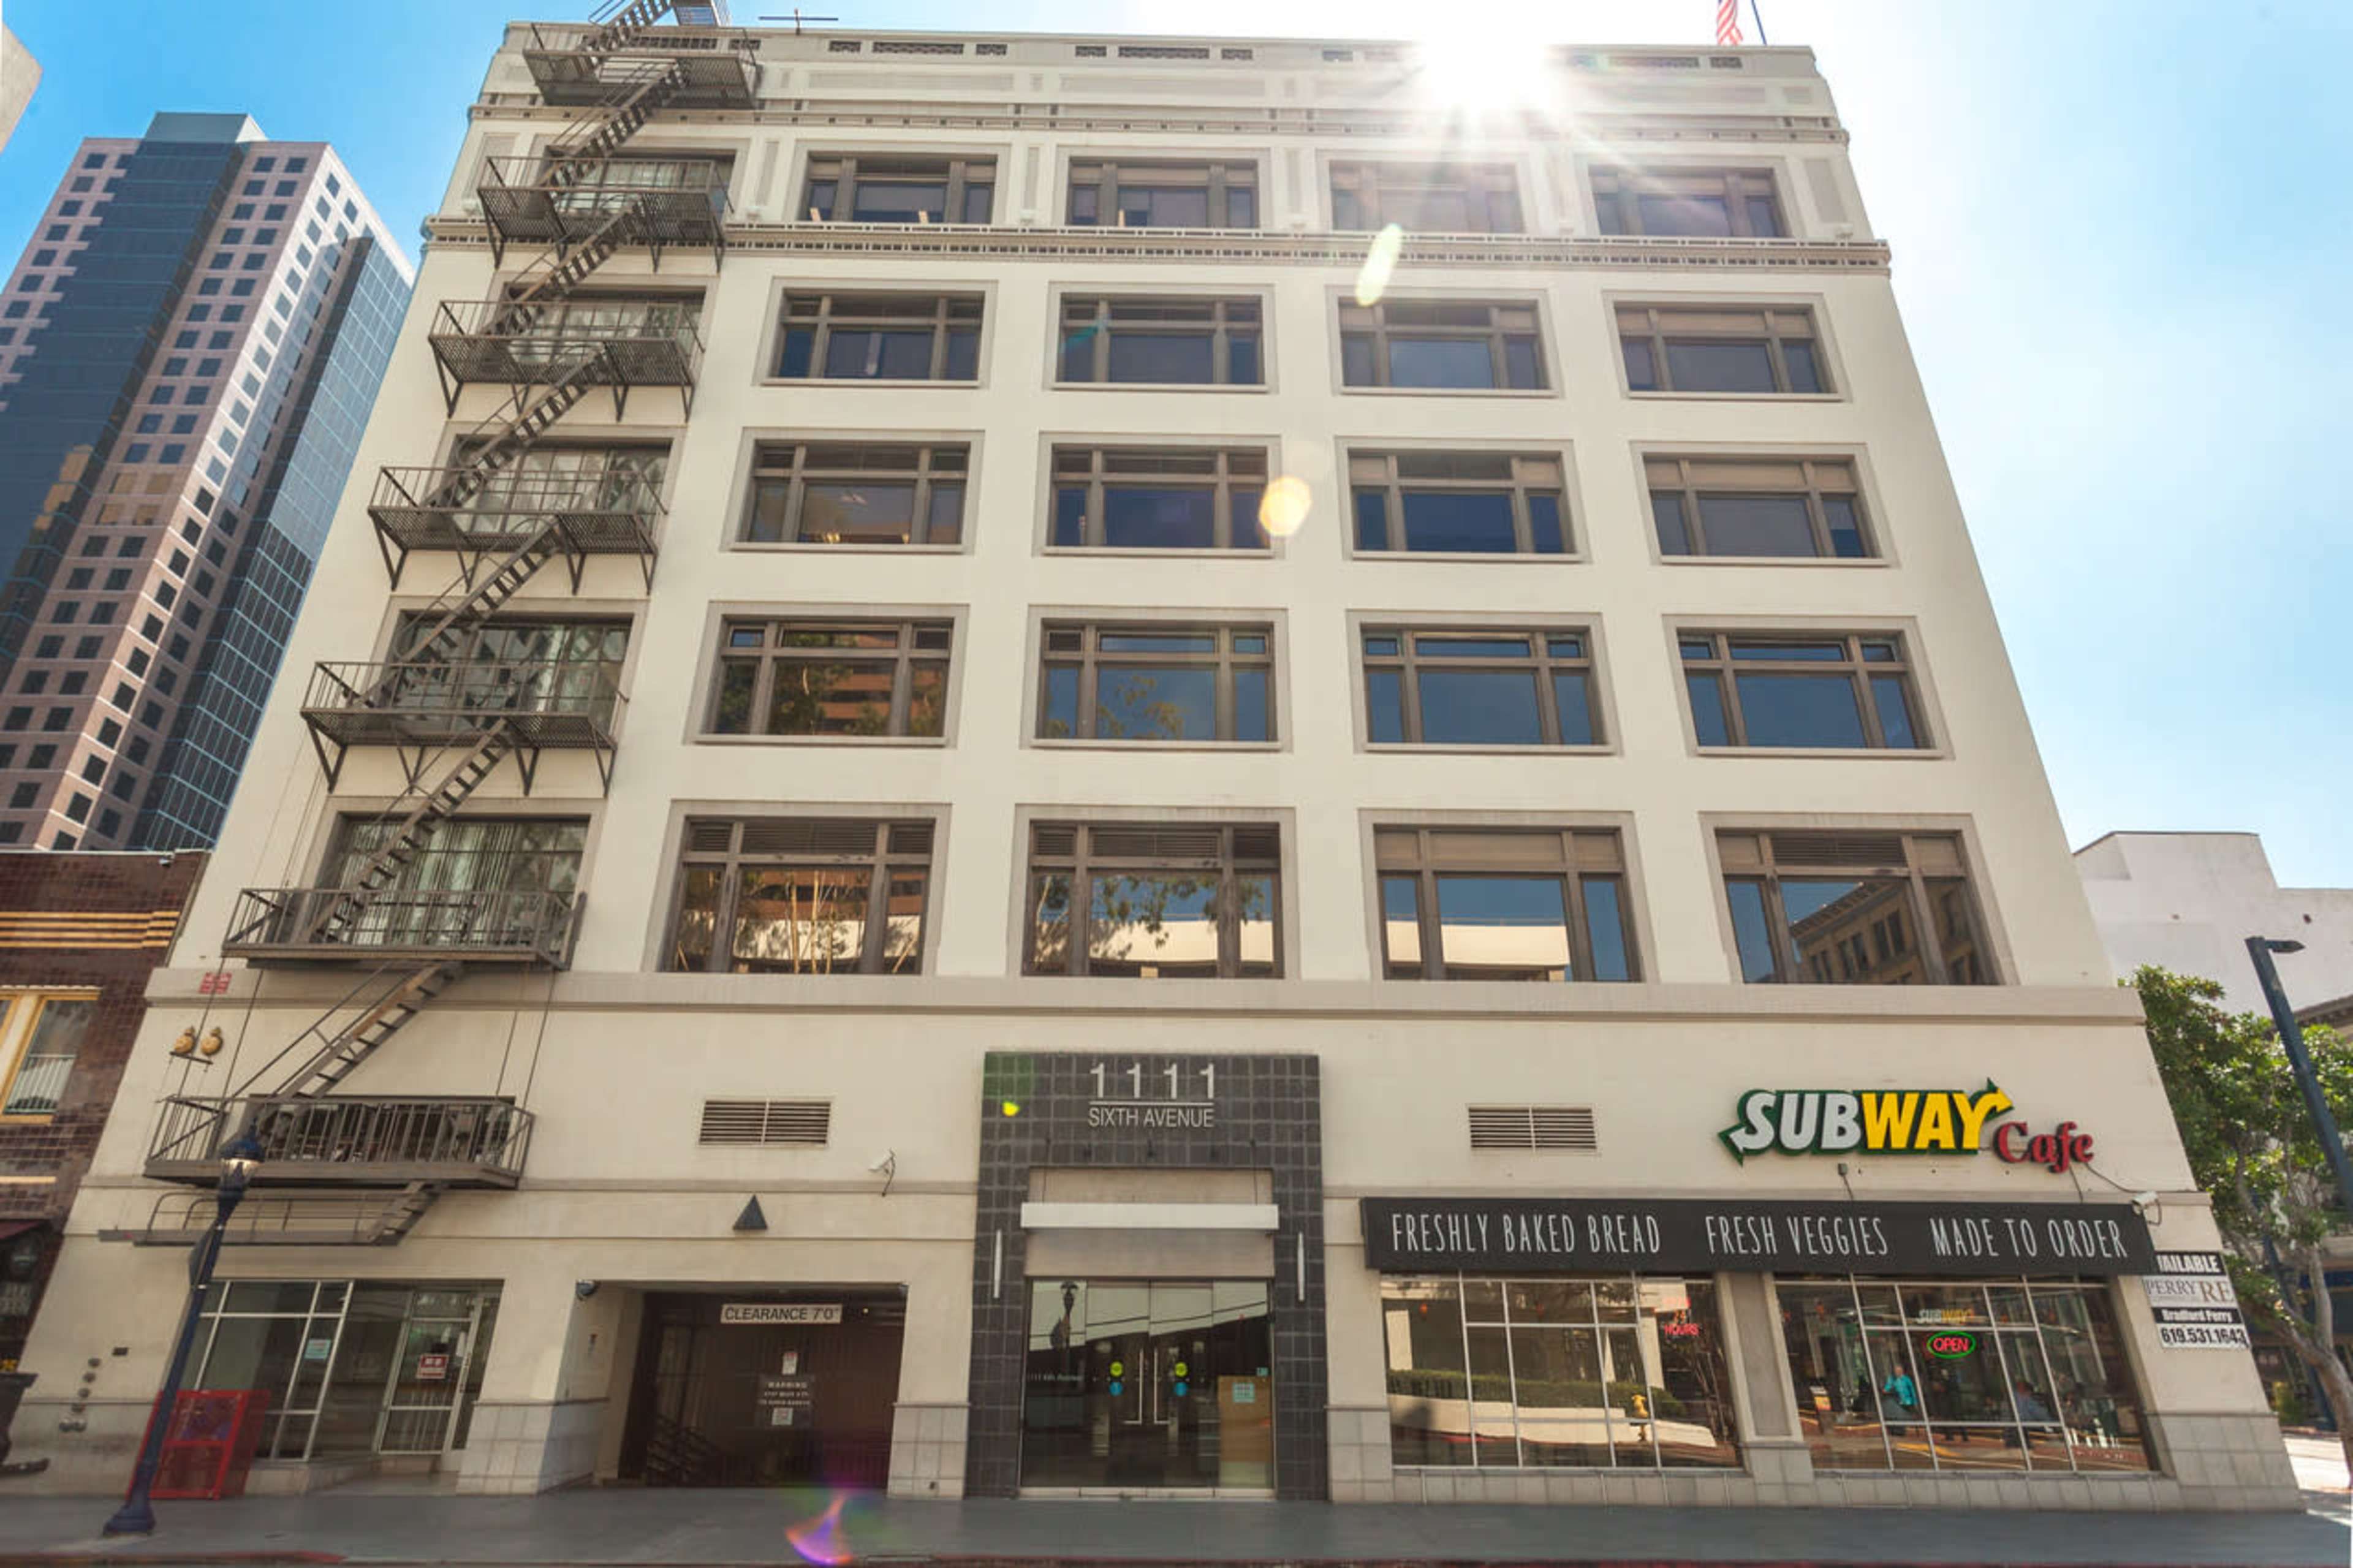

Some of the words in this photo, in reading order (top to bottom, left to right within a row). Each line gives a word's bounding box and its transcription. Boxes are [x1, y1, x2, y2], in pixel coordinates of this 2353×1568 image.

[1089, 1062, 1215, 1100] 1111
[1088, 1107, 1139, 1127] SIXTH
[1143, 1108, 1215, 1127] AVENUE
[1728, 1085, 2014, 1153] SUBWAY
[1995, 1121, 2095, 1173] Cafe
[1392, 1213, 1488, 1252] FRESHLY
[1502, 1214, 1575, 1253] BAKED
[1587, 1214, 1661, 1254] BREAD
[1705, 1215, 1778, 1256] FRESH
[1786, 1216, 1889, 1256] VEGGIES
[1930, 1217, 1999, 1258] MADE
[2006, 1218, 2037, 1258] TO
[2047, 1219, 2128, 1259] ORDER
[2146, 1278, 2197, 1295] PERRY
[2199, 1280, 2235, 1303] RE
[724, 1308, 808, 1320] CLEARANCE
[2206, 1309, 2232, 1324] Perry
[1933, 1336, 1969, 1352] OPEN
[2161, 1328, 2247, 1344] 619.531.1643
